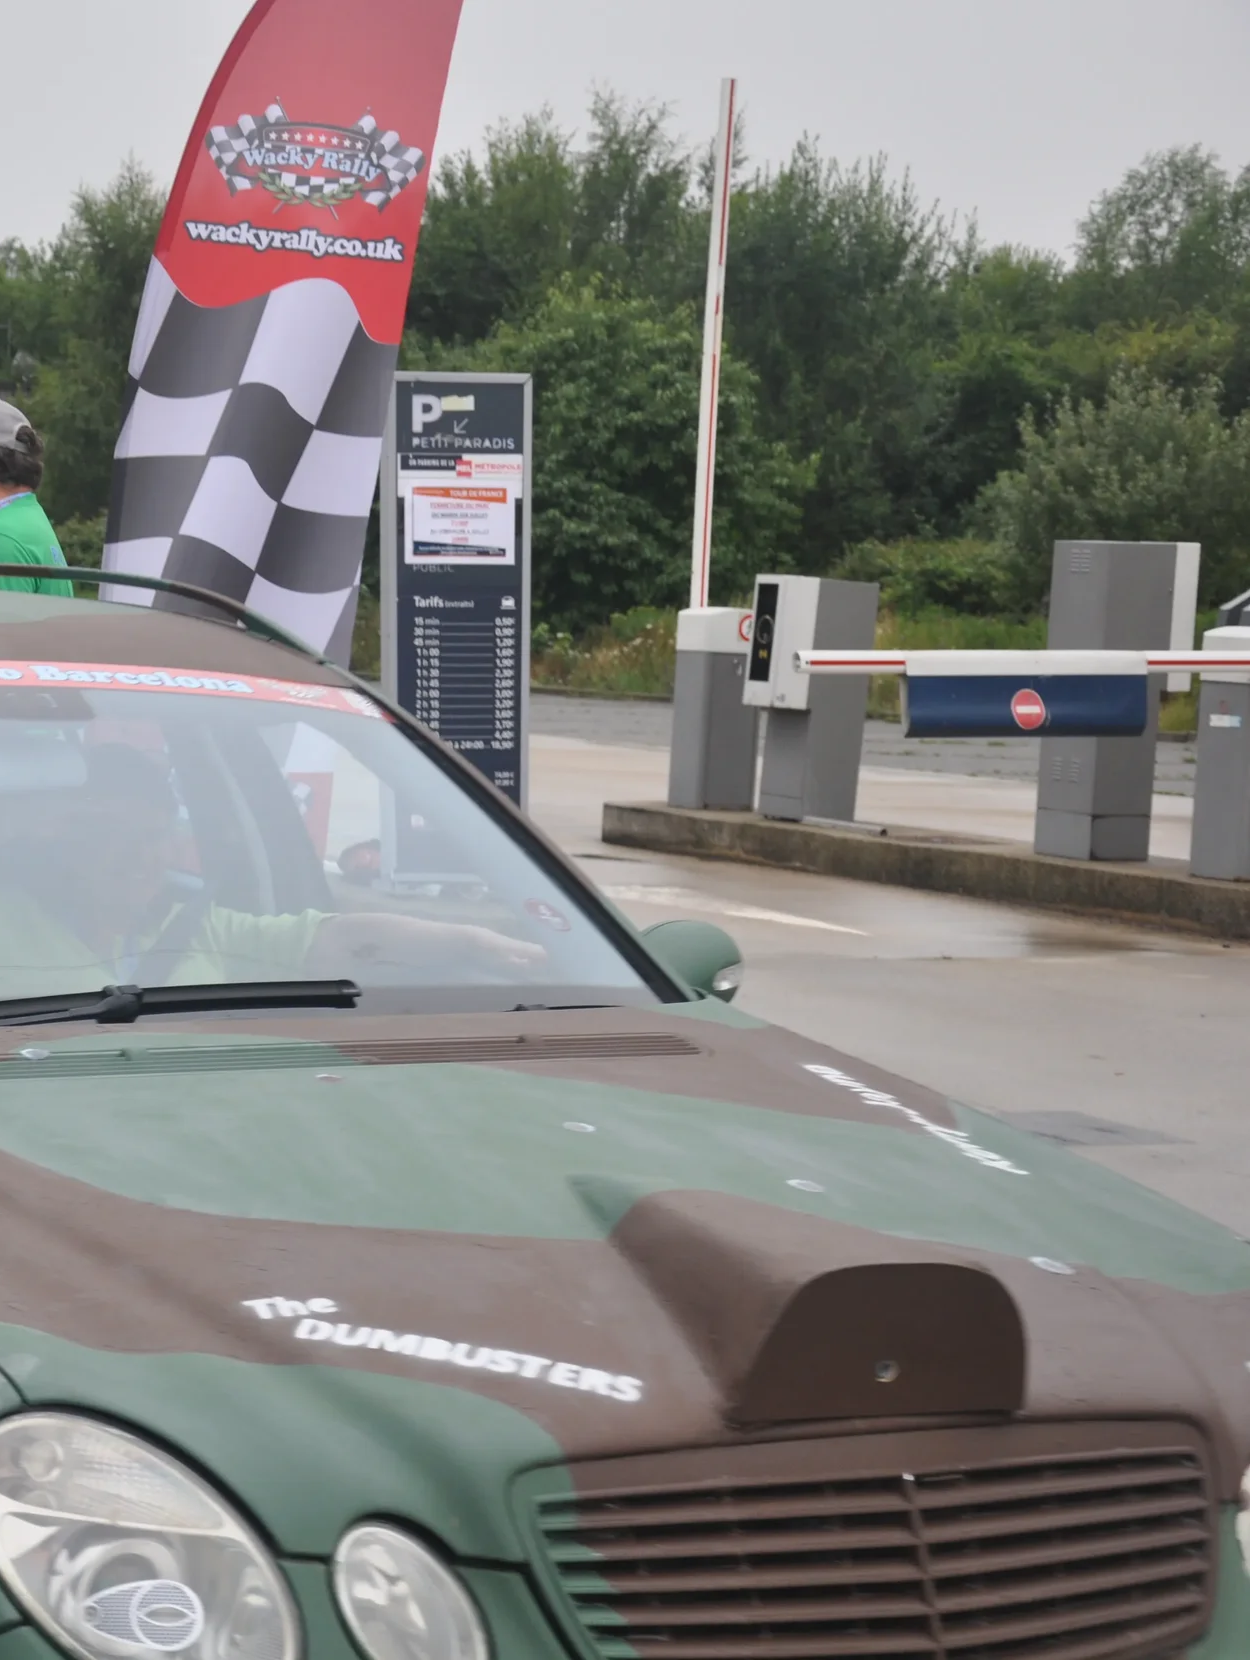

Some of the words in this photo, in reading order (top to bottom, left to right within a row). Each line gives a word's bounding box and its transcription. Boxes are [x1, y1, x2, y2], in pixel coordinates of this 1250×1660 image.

[243, 147, 318, 170] Wacky
[322, 150, 382, 181] Rally
[185, 220, 403, 260] wackyrally.co.uk
[411, 394, 443, 433] P
[411, 437, 450, 449] PETIT
[454, 437, 515, 450] PARADIS
[413, 596, 444, 608] Tarifs
[28, 664, 255, 694] Barcelona
[241, 1296, 338, 1320] The
[294, 1318, 644, 1403] DUMBUSTERS
